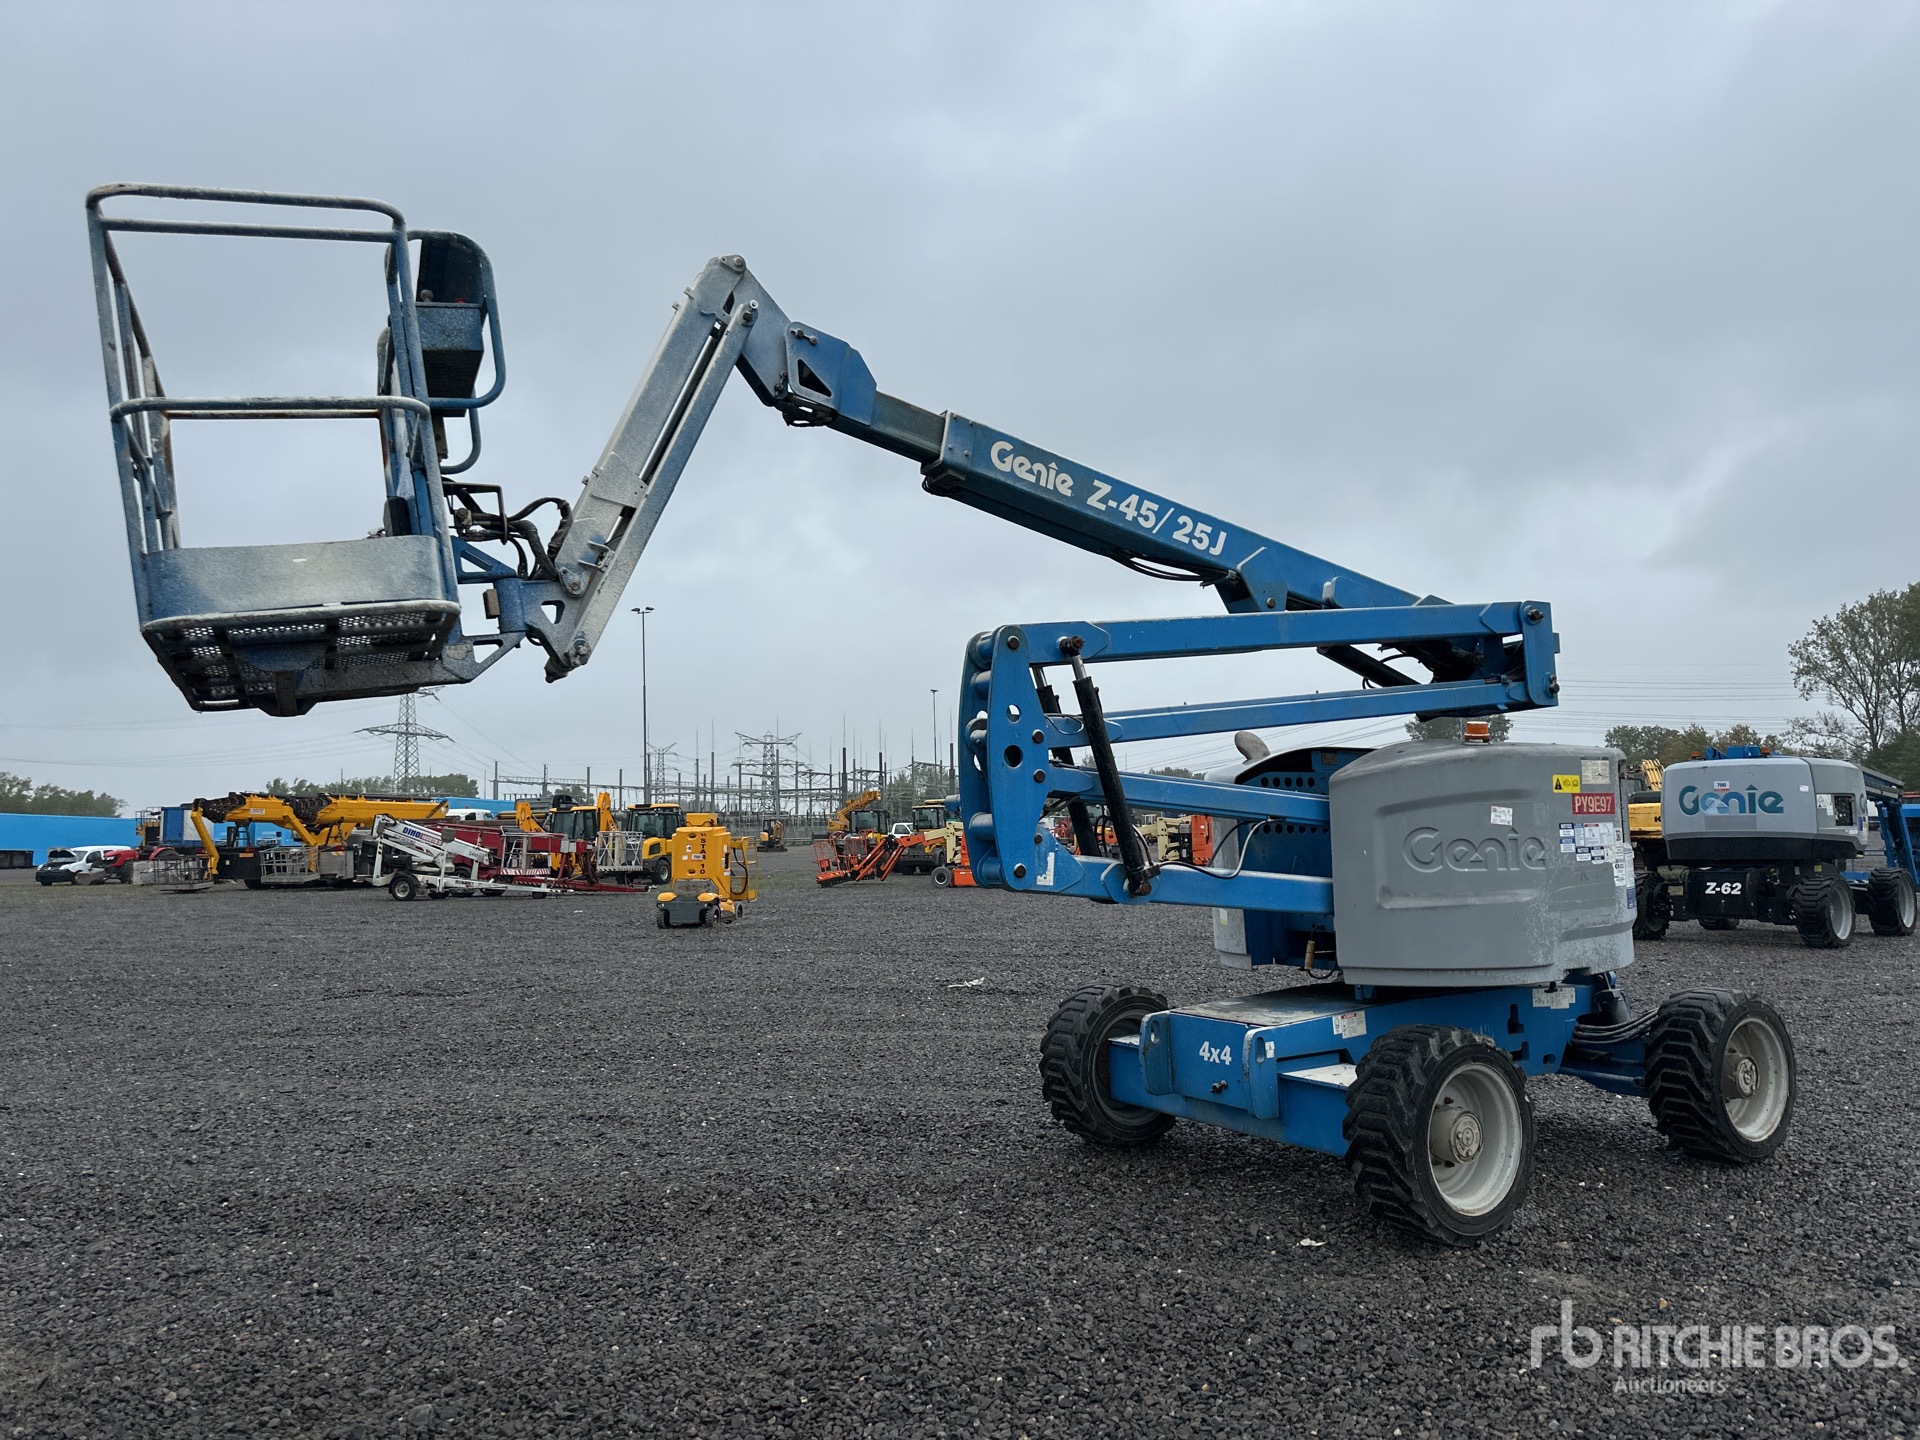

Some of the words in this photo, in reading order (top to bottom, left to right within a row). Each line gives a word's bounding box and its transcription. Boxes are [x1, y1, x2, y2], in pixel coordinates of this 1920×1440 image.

[990, 440, 1074, 497] Genie
[1574, 795, 1612, 813] PY9E97
[1678, 784, 1784, 817] Genie
[402, 826, 421, 838] DINO
[1402, 826, 1547, 873] Genie
[1704, 881, 1742, 895] Z-62
[1198, 1041, 1232, 1065] 4x4
